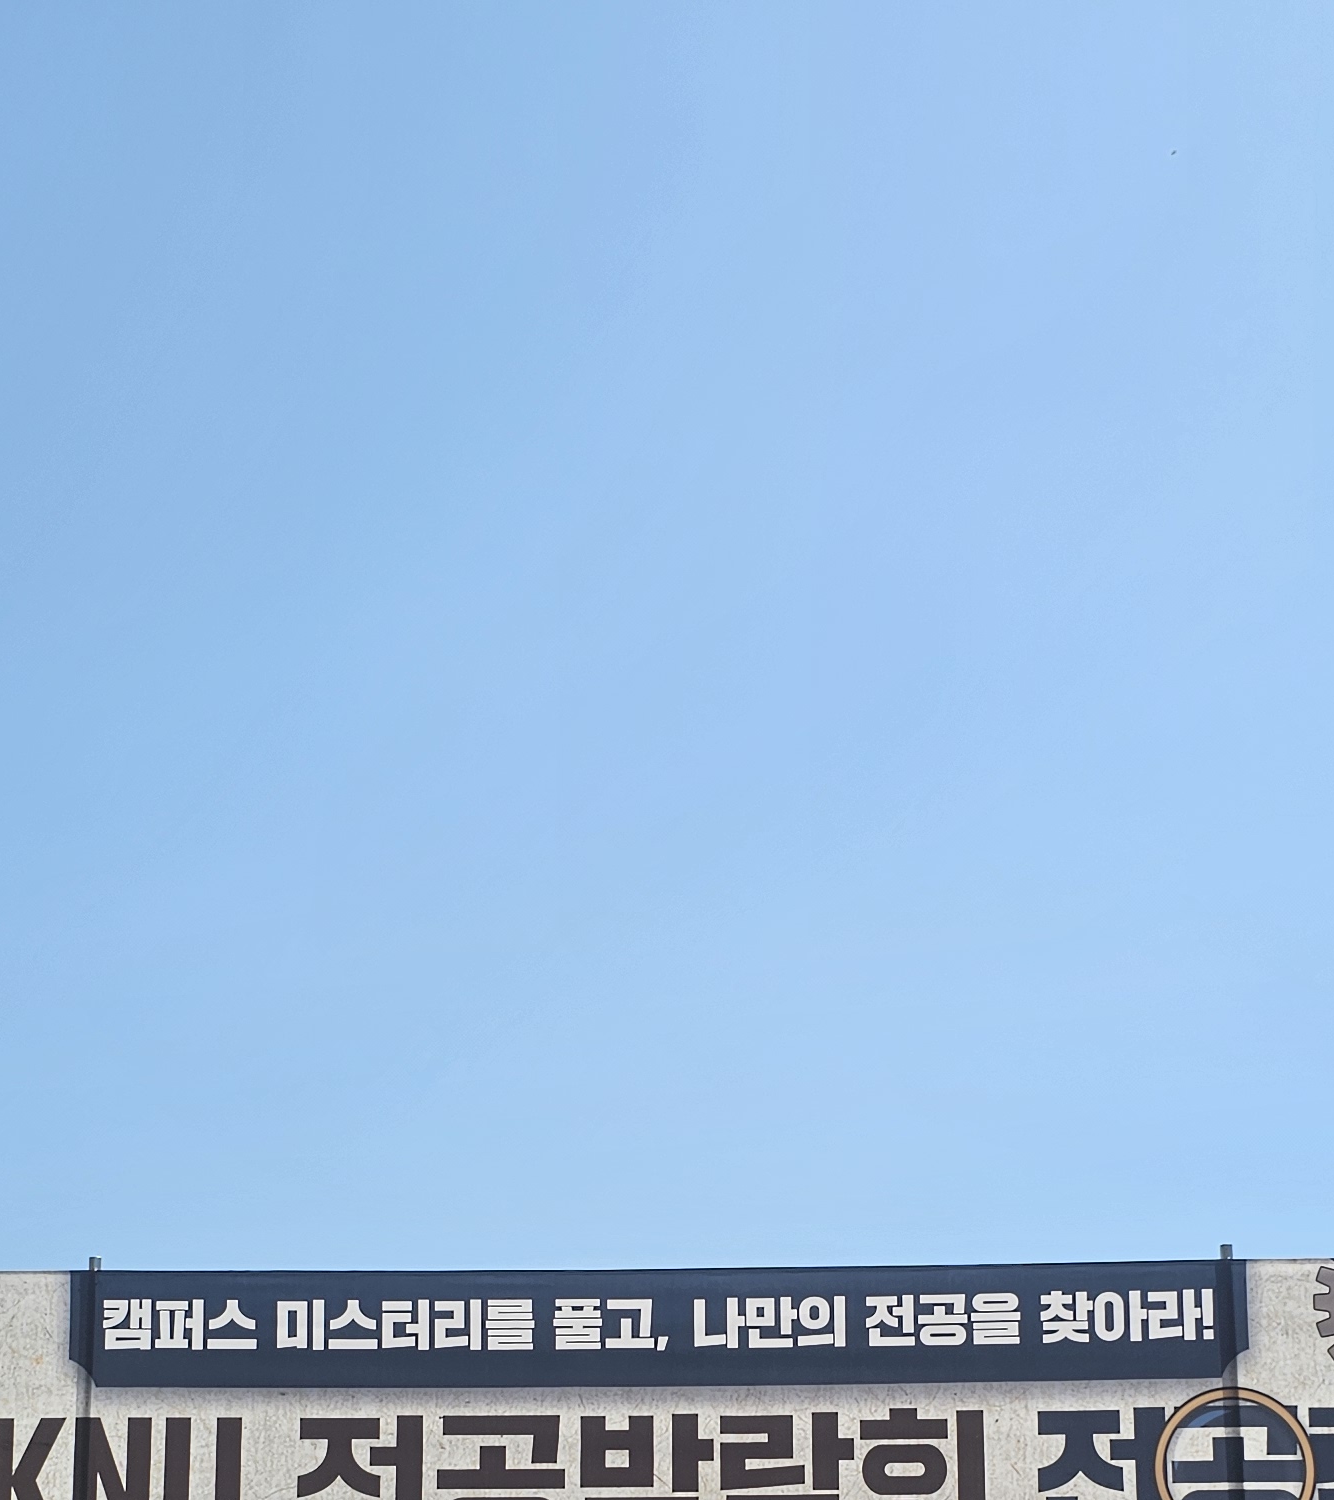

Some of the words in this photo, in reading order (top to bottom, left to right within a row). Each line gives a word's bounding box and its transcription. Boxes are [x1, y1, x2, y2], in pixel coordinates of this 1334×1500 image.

[102, 1298, 257, 1352] 캠퍼스
[276, 1297, 536, 1352] 미스터리를
[552, 1297, 669, 1353] 풀고,
[693, 1294, 848, 1349] 나만의
[864, 1292, 1021, 1347] 전공을
[1040, 1288, 1215, 1344] 찾아라!
